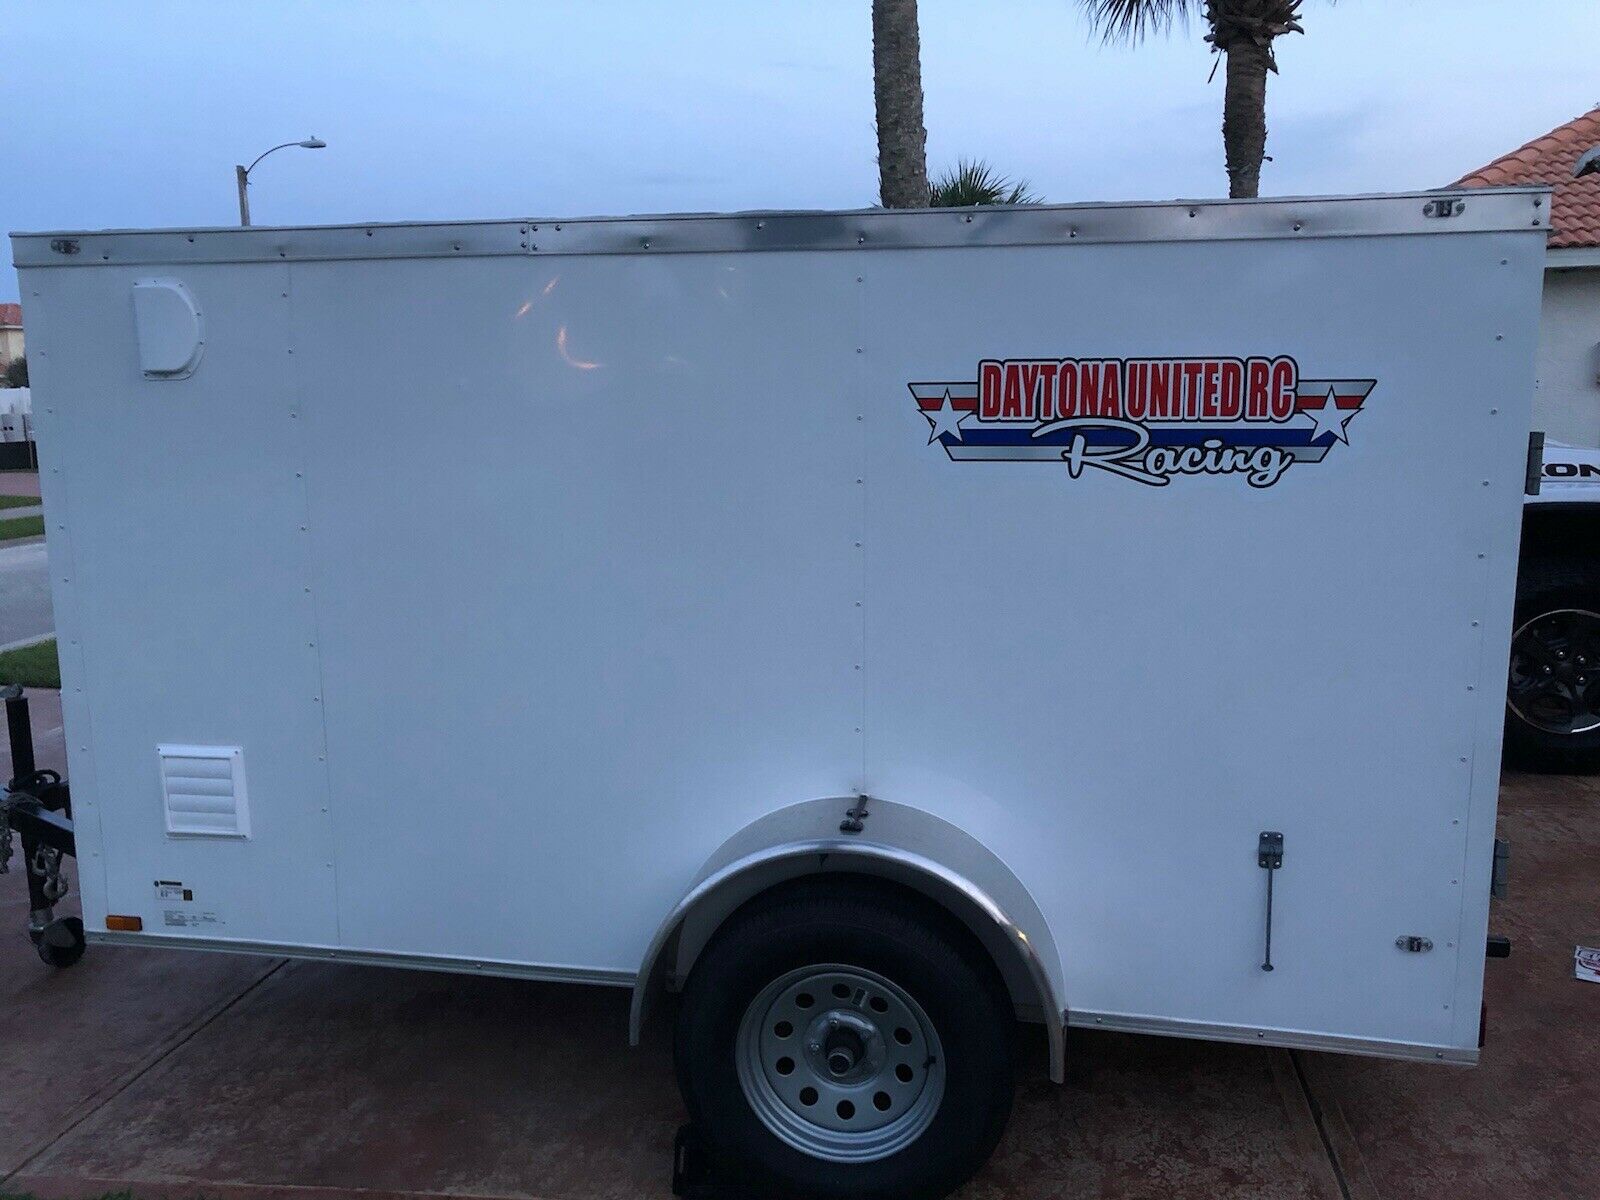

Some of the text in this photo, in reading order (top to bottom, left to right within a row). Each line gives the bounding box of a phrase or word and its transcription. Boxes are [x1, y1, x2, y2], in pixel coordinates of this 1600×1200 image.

[981, 359, 1298, 420] DAYTONA UNITED RC
[1030, 417, 1295, 488] Racing
[1541, 463, 1600, 477] ON
